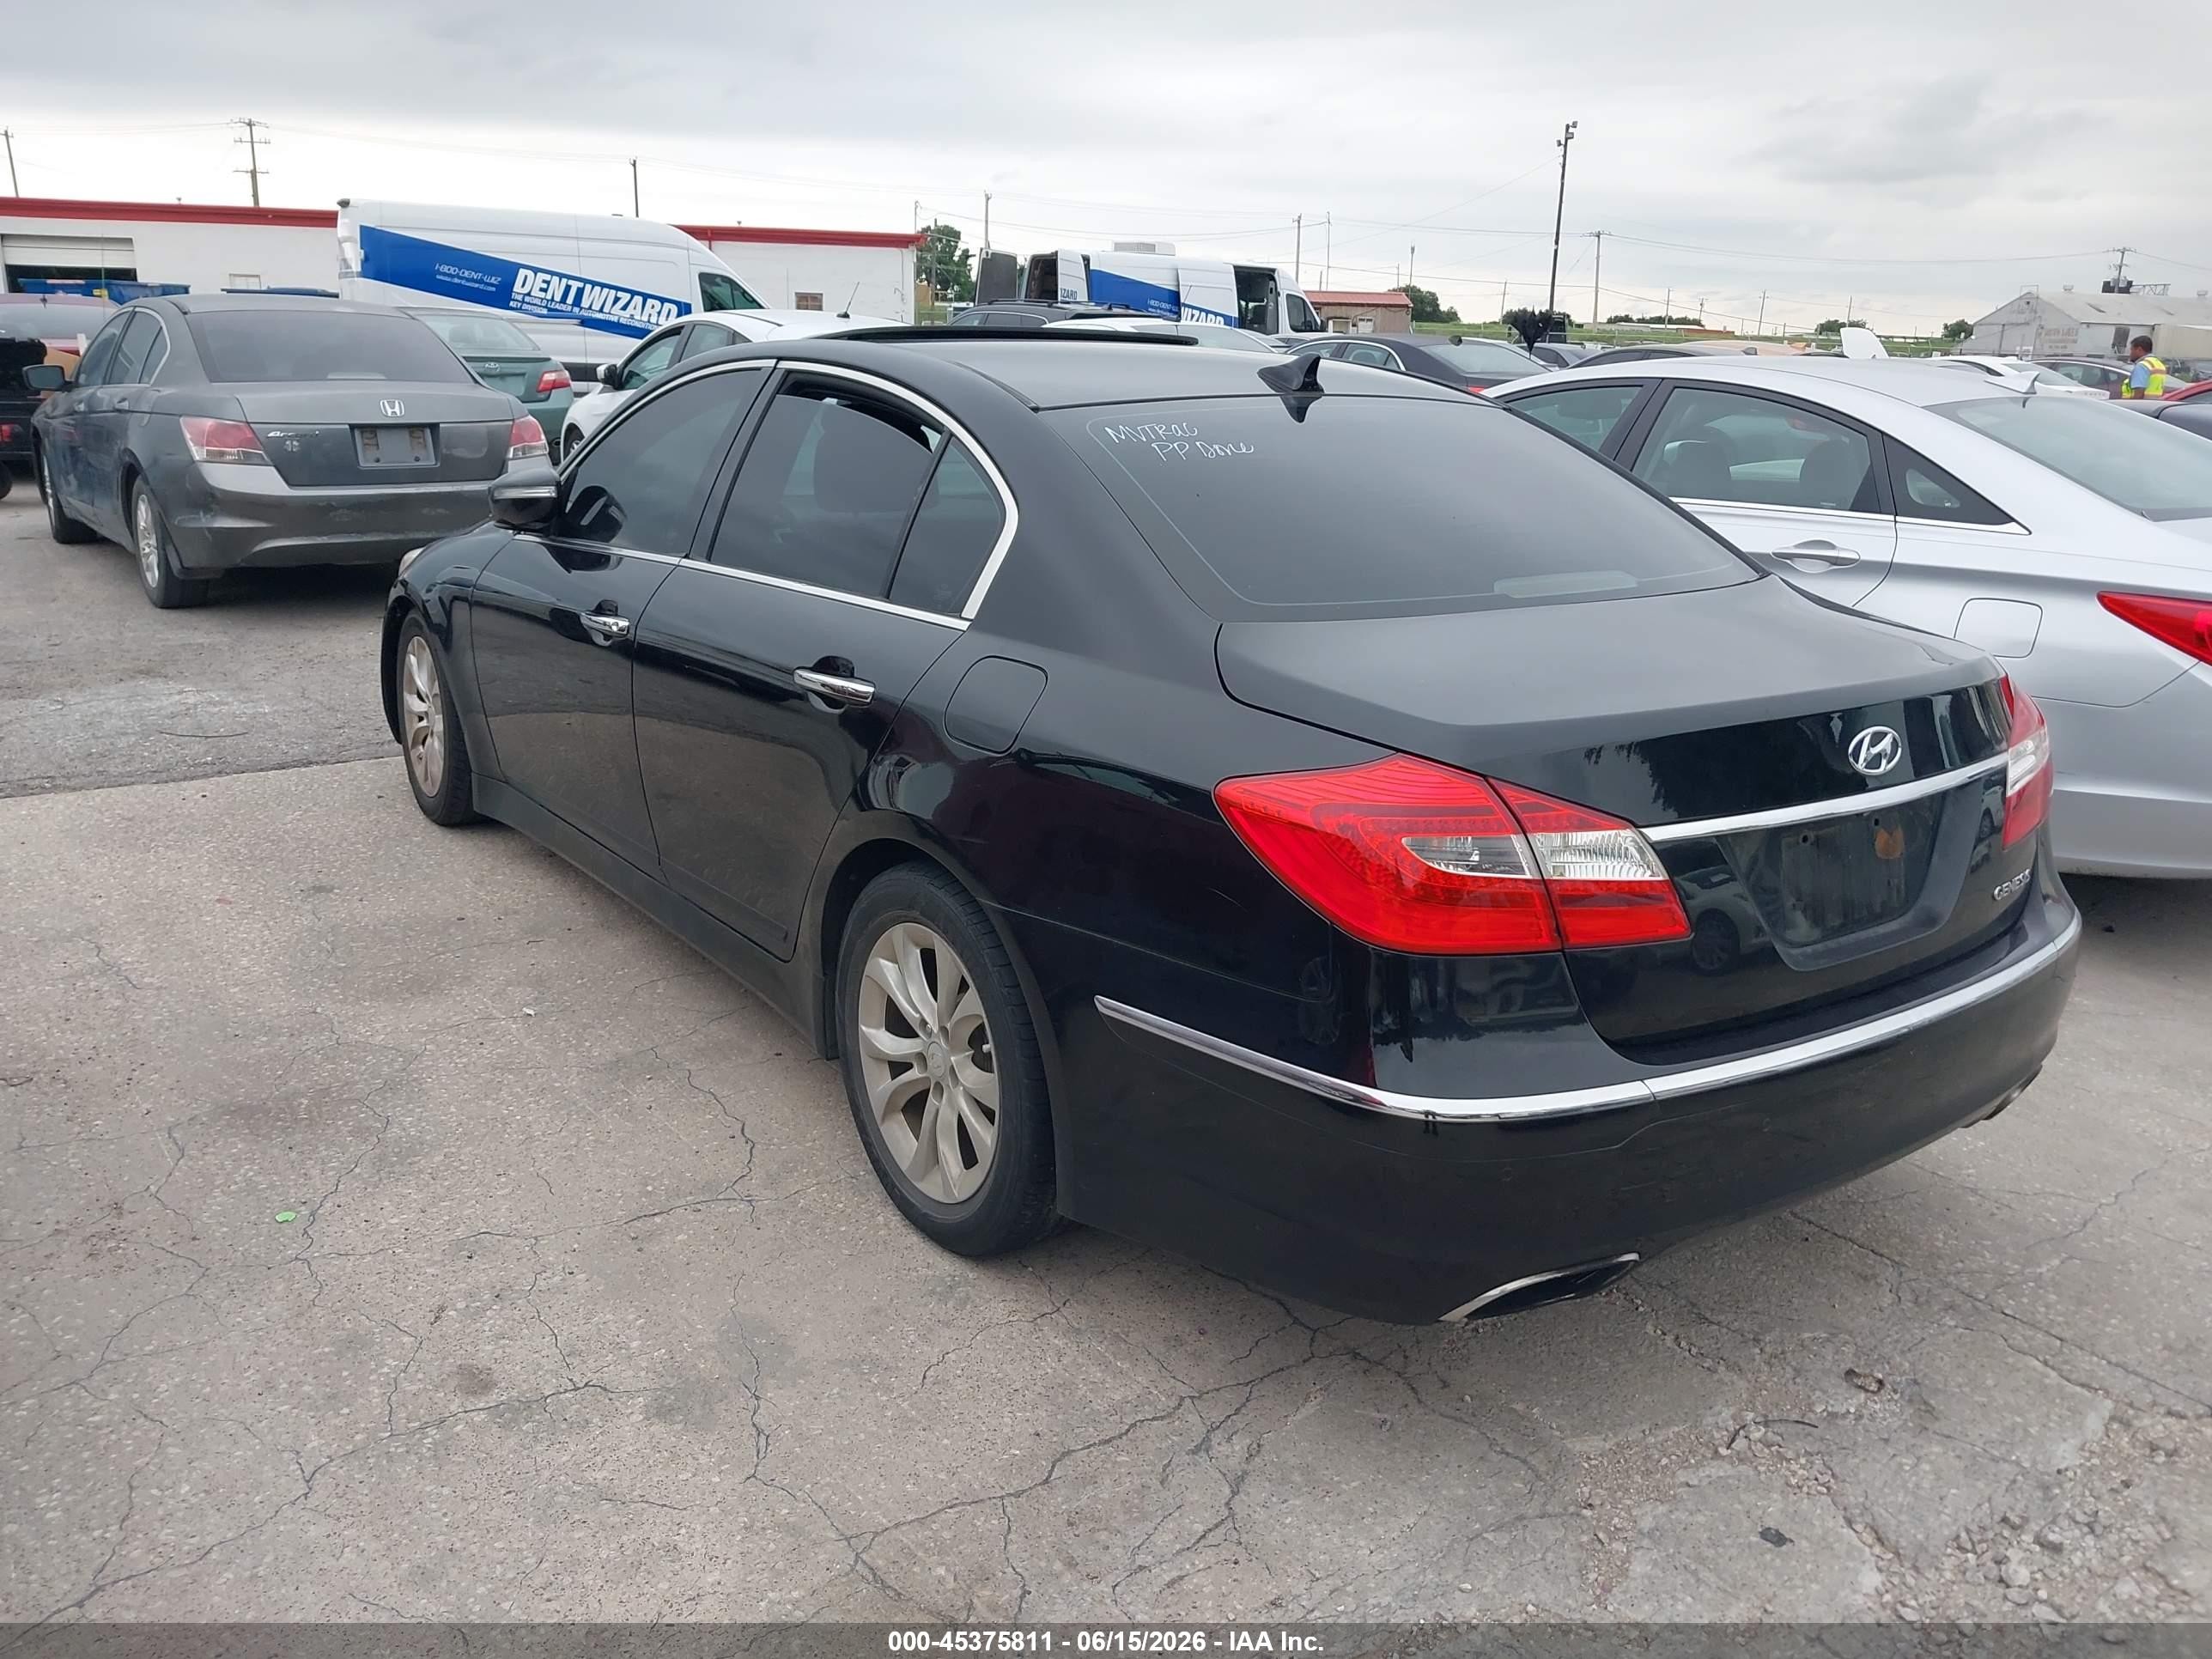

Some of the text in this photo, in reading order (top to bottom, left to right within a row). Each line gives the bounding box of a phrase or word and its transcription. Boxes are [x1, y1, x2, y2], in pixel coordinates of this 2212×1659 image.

[508, 301, 522, 310] KEY
[511, 293, 523, 301] THE
[524, 295, 547, 306] WORLD
[547, 301, 573, 313] LEADER
[1993, 868, 2031, 901] GENESIS
